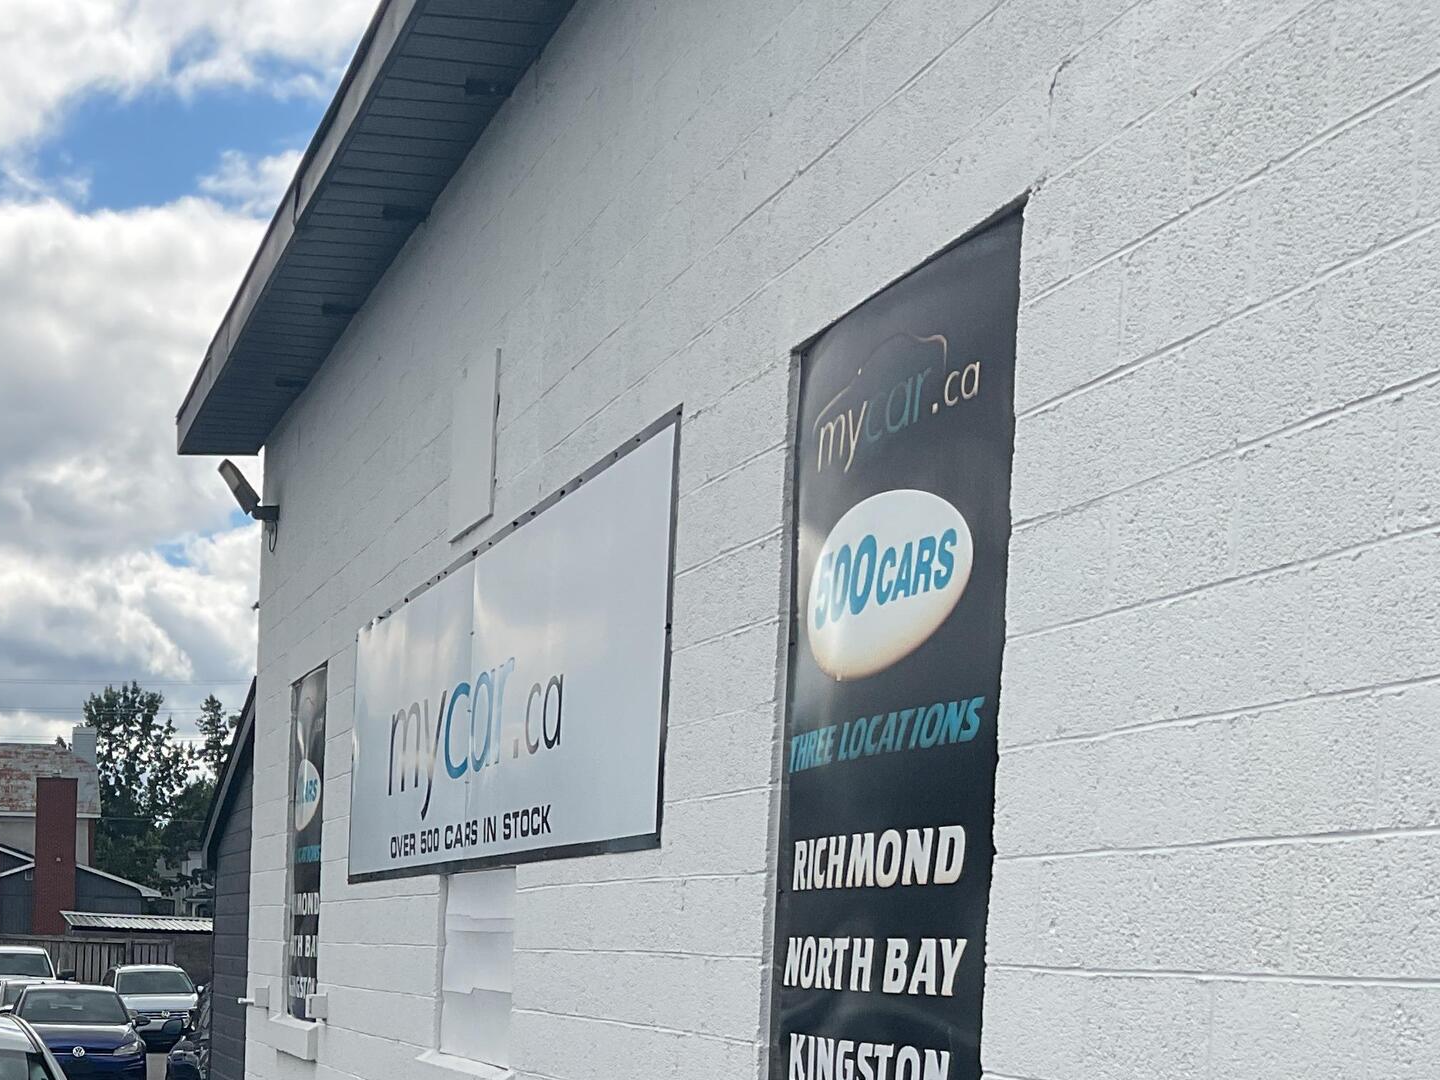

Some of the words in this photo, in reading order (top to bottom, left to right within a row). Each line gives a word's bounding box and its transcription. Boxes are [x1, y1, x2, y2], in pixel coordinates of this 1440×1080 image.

[816, 360, 981, 473] mycar.ca
[388, 656, 564, 821] mycar.ca
[788, 724, 838, 774] THREE
[838, 696, 985, 762] LOCATIONS
[390, 832, 416, 859] OVER
[420, 827, 440, 854] 500
[444, 819, 478, 850] CARS
[483, 815, 497, 844] IN
[503, 804, 552, 841] STOCK
[792, 825, 966, 892] RICHMOND
[783, 936, 874, 993] NORTH
[882, 938, 967, 998] BAY
